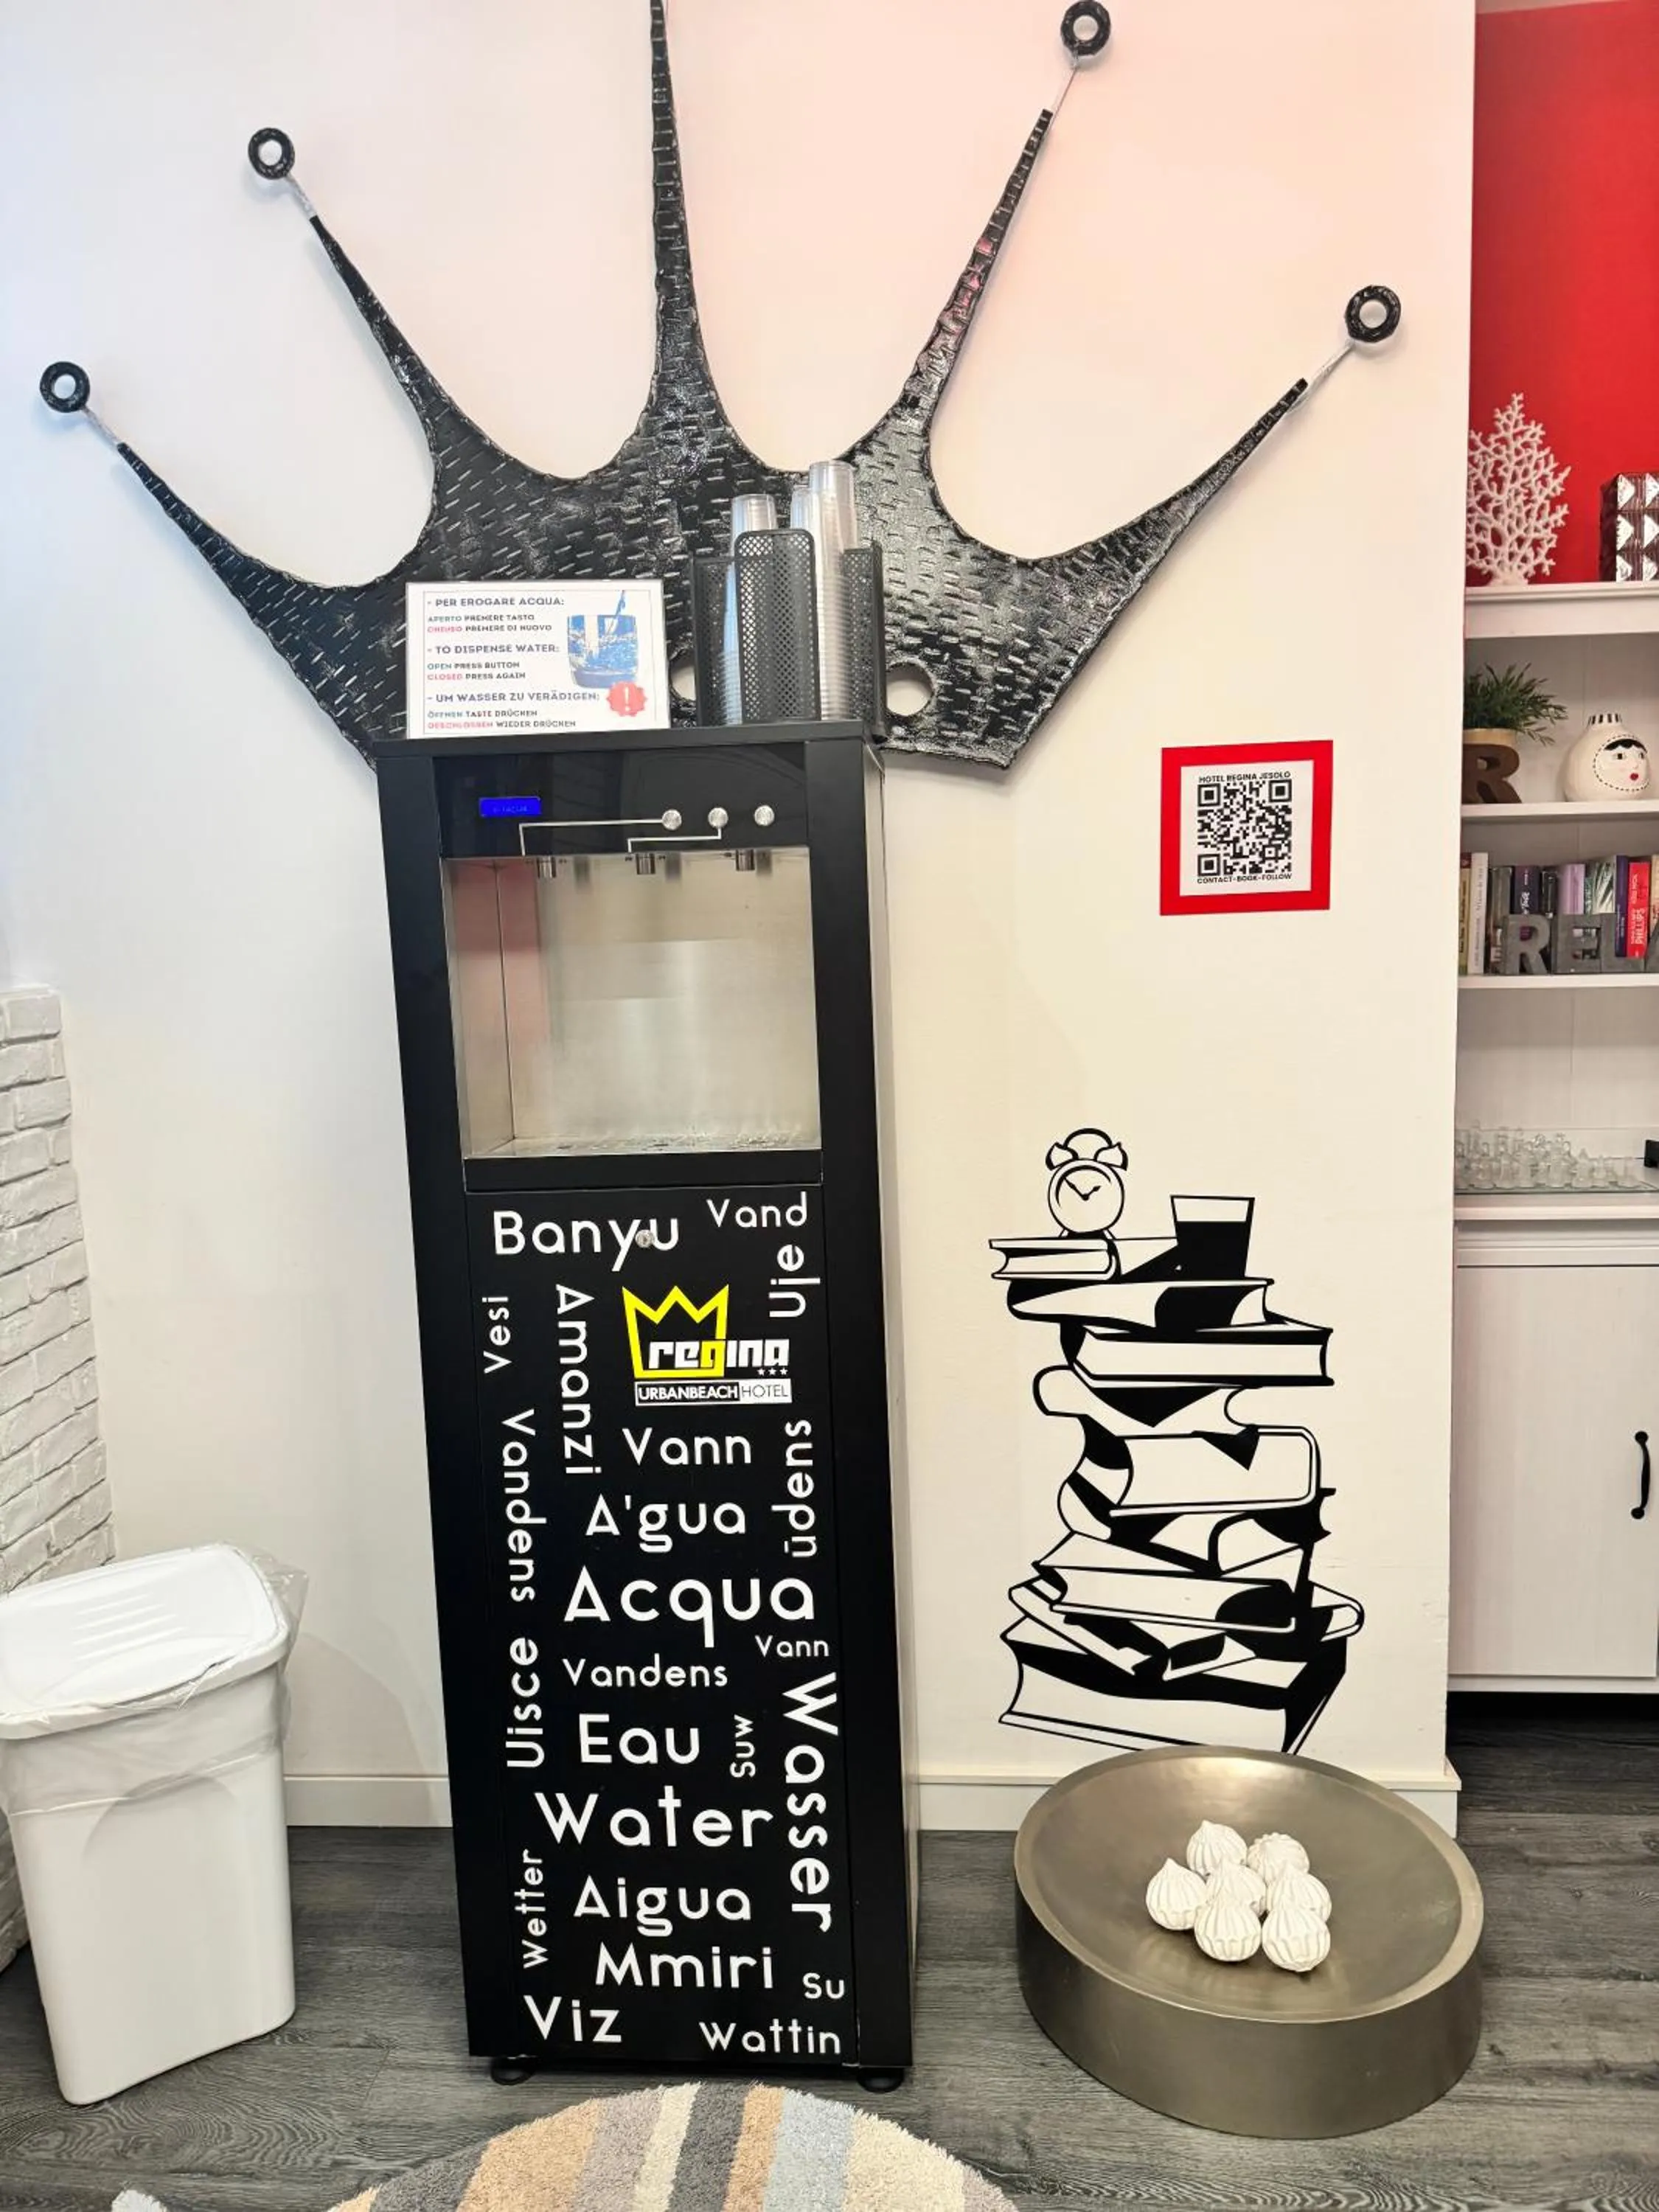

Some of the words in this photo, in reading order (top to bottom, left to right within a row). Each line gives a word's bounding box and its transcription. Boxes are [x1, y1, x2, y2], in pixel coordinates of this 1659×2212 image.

[436, 599, 456, 607] PER
[460, 597, 515, 607] EROGARE
[518, 597, 564, 605] ACQUA:
[436, 646, 451, 654] TO
[454, 645, 512, 654] DISPENSE
[516, 644, 560, 653] WATER:
[437, 693, 453, 703] UM
[457, 692, 507, 702] WASSER
[510, 692, 524, 701] ZU
[1198, 774, 1225, 782] HOTEL
[1226, 773, 1256, 782] REGINA
[707, 1192, 807, 1228] Vand
[493, 1210, 679, 1271] Banyu
[768, 1244, 821, 1318] Uje
[481, 1296, 512, 1374] Vesi
[649, 1339, 790, 1372] regina
[556, 1284, 602, 1474] Amanzi
[639, 1385, 738, 1399] URBANBEACH
[741, 1385, 788, 1397] HOTEL
[622, 1427, 751, 1465] Vann
[502, 1409, 547, 1602] Vandens
[585, 1494, 745, 1553] A'gua
[563, 1565, 815, 1648] Acqua
[562, 1653, 728, 1687] Vandens
[754, 1635, 830, 1658] Vann
[505, 1637, 545, 1767] Uisce
[579, 1714, 700, 1764] Eau
[729, 1714, 756, 1778] Suw
[534, 1786, 773, 1847] Water
[782, 1672, 838, 1933] Wasser
[515, 1848, 548, 1969] Wetter
[574, 1875, 751, 1937] Aigua
[595, 1942, 773, 1989] Mmiri
[802, 1972, 845, 2000] Su
[524, 1995, 622, 2043] Viz
[699, 2019, 841, 2054] Wattin
